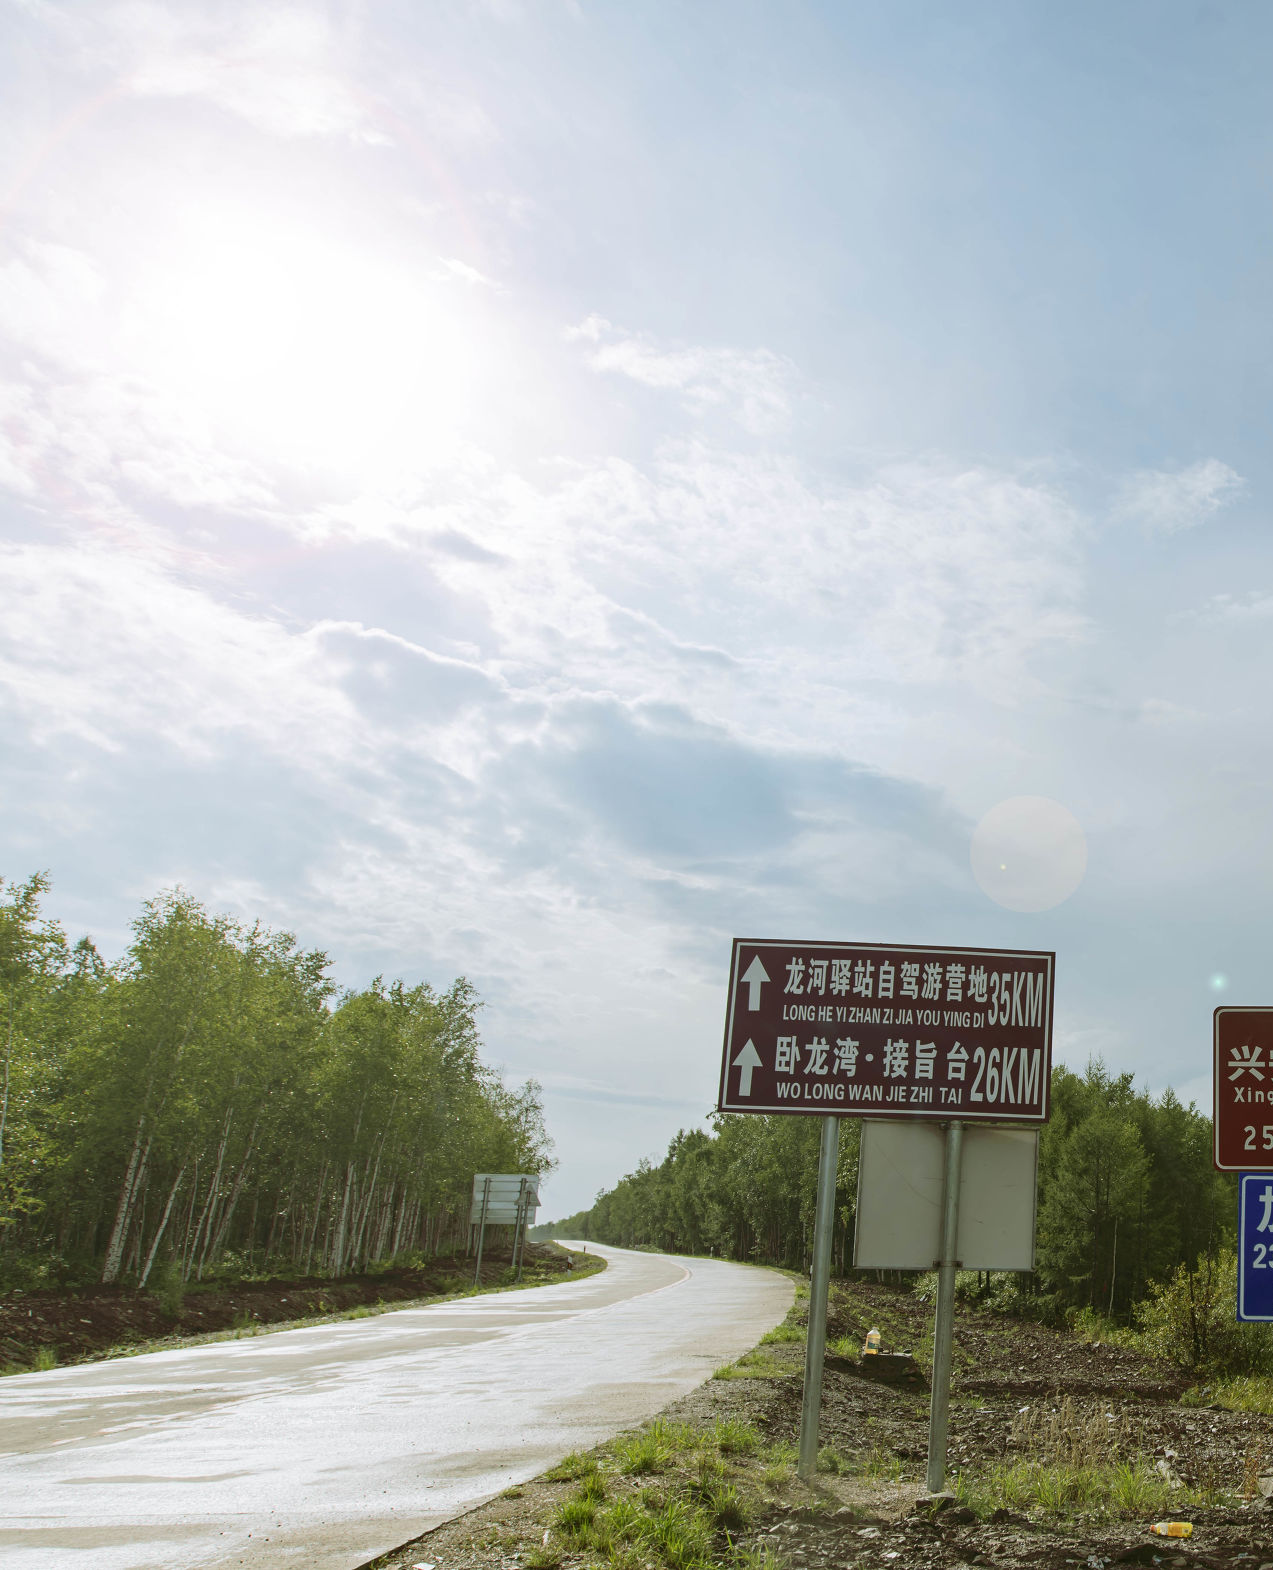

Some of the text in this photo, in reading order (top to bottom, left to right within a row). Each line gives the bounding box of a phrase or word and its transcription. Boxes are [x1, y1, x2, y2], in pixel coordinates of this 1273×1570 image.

[783, 956, 1044, 1028] 龙河驿站自驾游营地 35KM
[782, 1004, 985, 1029] LONG HE YI ZHAN ZI JIA YOU YING DI
[776, 1082, 962, 1105] WO LONG WAN JIE ZHI TAI
[970, 1046, 1041, 1105] 26KM
